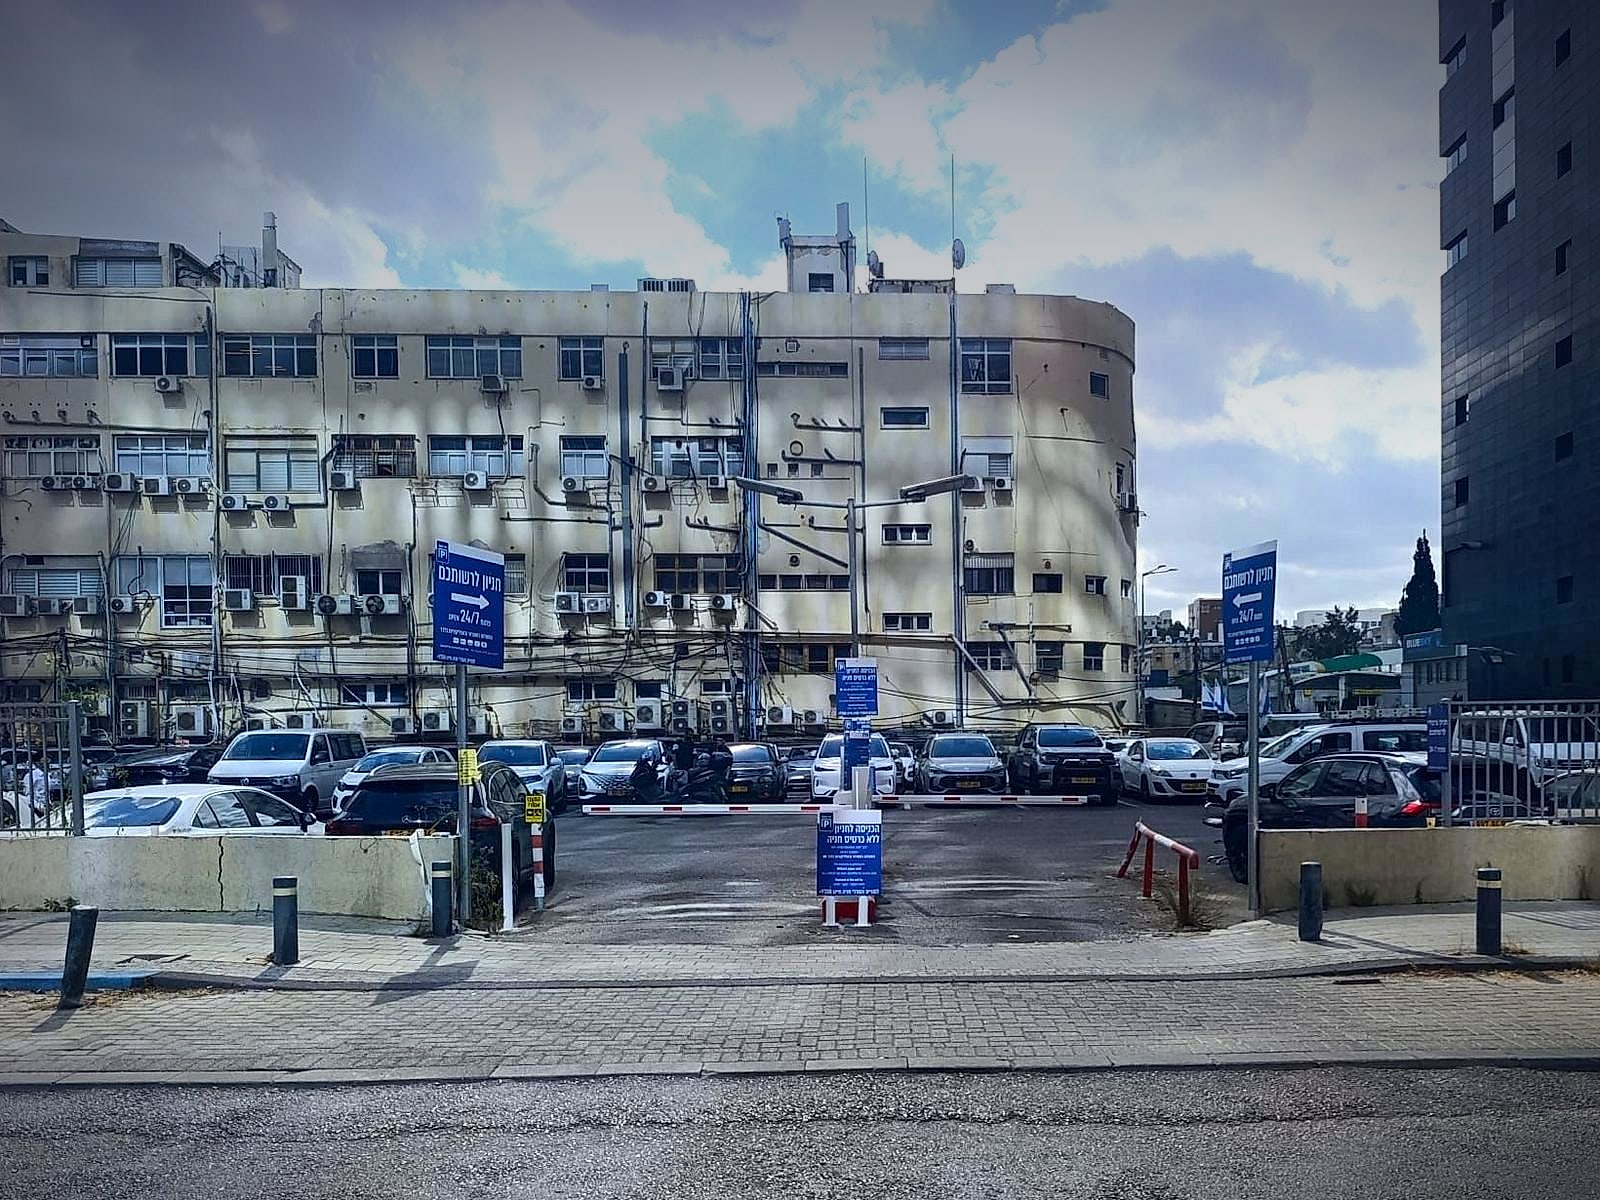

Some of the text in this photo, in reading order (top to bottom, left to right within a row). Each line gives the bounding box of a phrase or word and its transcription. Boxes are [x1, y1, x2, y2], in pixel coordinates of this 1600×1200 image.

[438, 564, 502, 592] חניון לרשותכם
[1224, 566, 1273, 590] חניון לרשותכם
[460, 609, 480, 625] 24/7
[1239, 608, 1254, 624] 24/7
[834, 824, 880, 835] הכניסה לחניון
[826, 834, 880, 844] ללא כרטיס חניה
